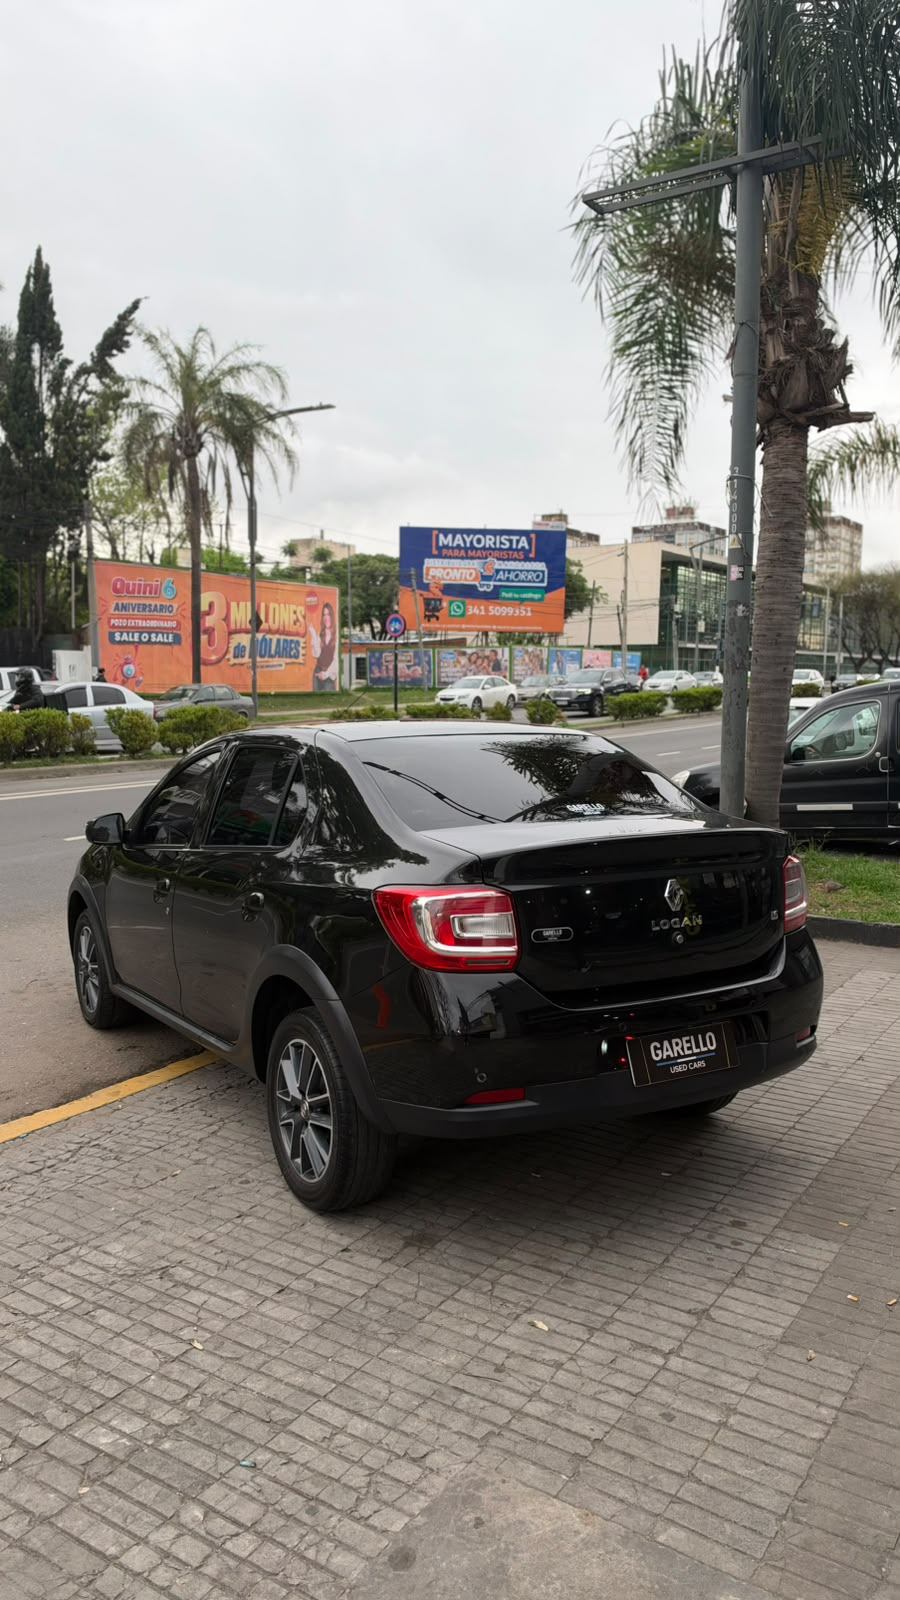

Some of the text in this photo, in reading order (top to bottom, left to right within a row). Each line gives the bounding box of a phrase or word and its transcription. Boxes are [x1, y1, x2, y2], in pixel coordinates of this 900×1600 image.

[438, 533, 529, 549] MAYORISTA
[442, 548, 525, 560] PARA MAYORISTAS
[428, 566, 543, 582] PRONTO AHORRO
[112, 577, 177, 599] Quini 6
[113, 602, 174, 613] ANIVERSARIO
[467, 605, 485, 615] 341
[230, 601, 306, 632] MILONES
[200, 591, 229, 665] 3
[114, 632, 174, 643] SALE O SALE
[233, 643, 247, 659] de
[651, 914, 702, 931] LOGAN
[650, 1032, 717, 1061] GARELLO
[670, 1060, 706, 1074] USED CARS
